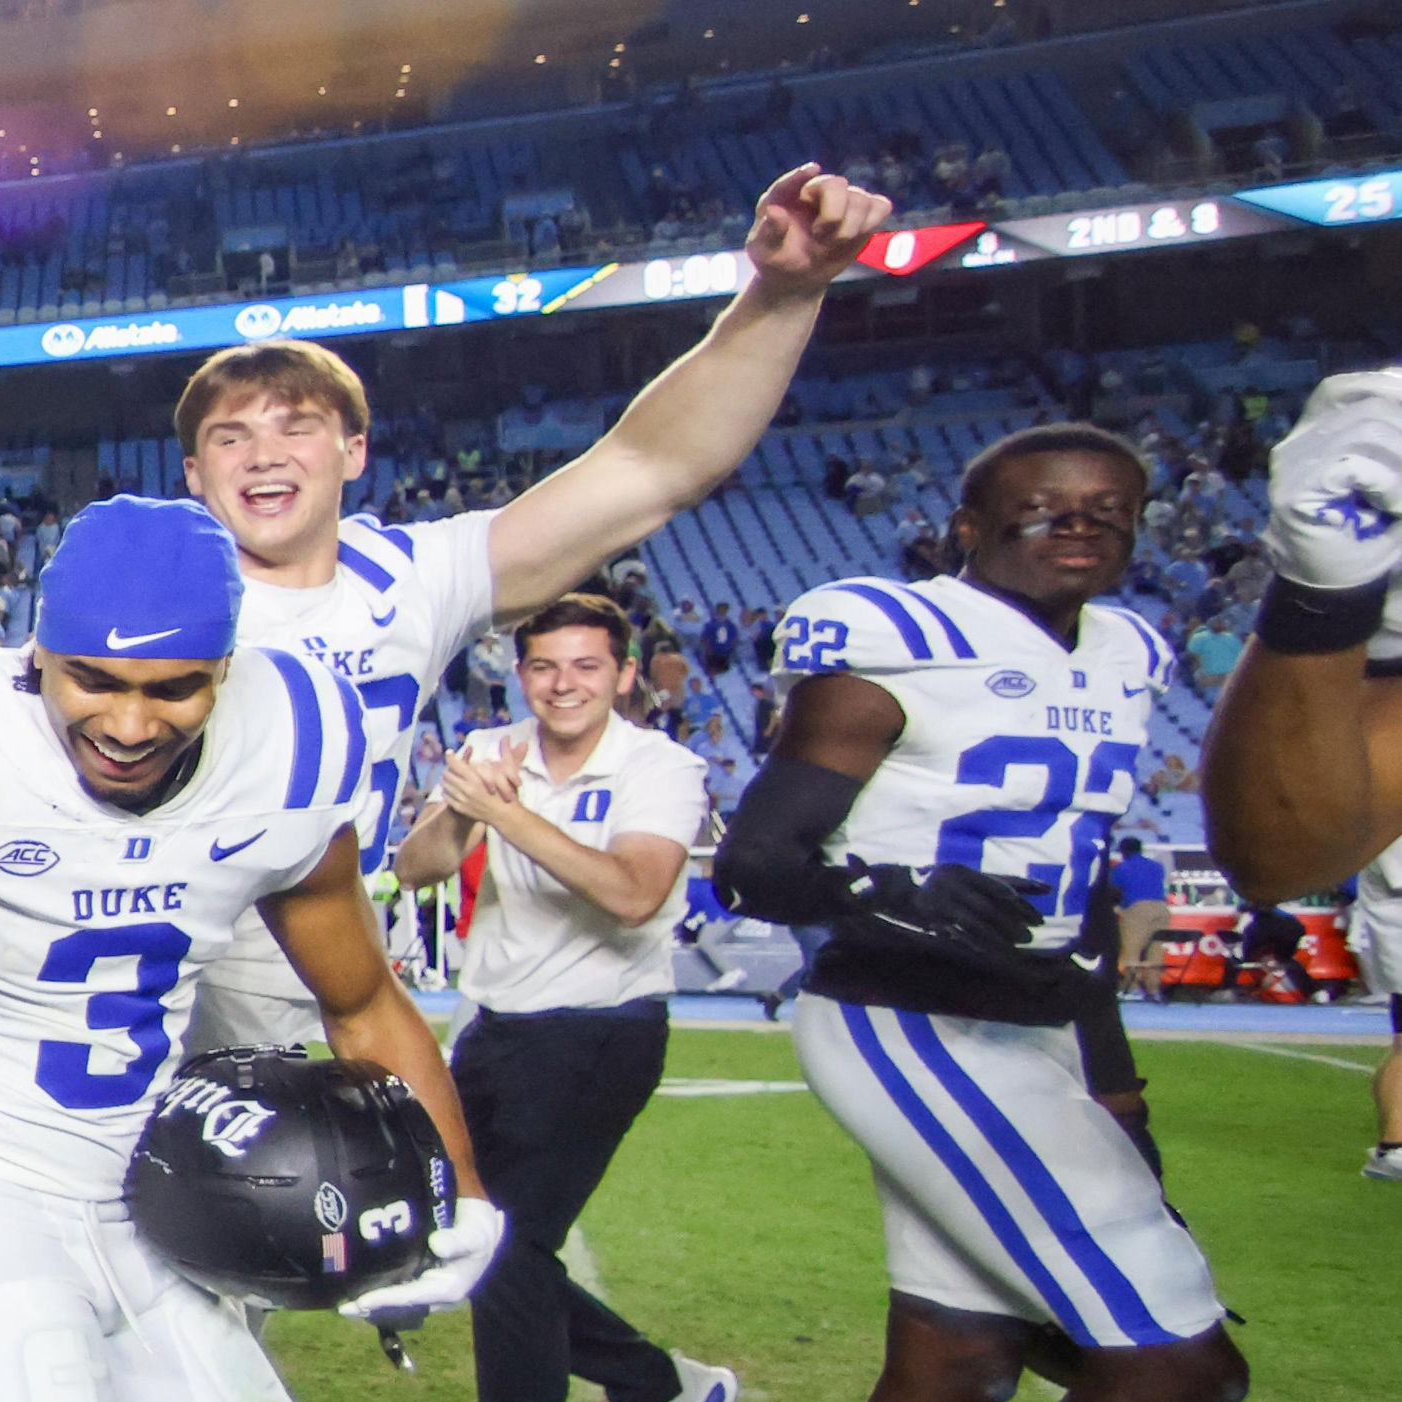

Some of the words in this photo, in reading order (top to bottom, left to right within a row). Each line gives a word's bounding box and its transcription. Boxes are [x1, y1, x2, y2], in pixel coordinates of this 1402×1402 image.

[1323, 181, 1394, 222] 25
[1067, 211, 1141, 249] 2ND
[1146, 207, 1186, 239] &
[492, 278, 543, 315] 32
[782, 615, 851, 672] 22
[1045, 705, 1113, 736] DUKE
[72, 882, 188, 921] DUKE
[35, 922, 191, 1110] 3
[358, 1200, 412, 1241] 3
